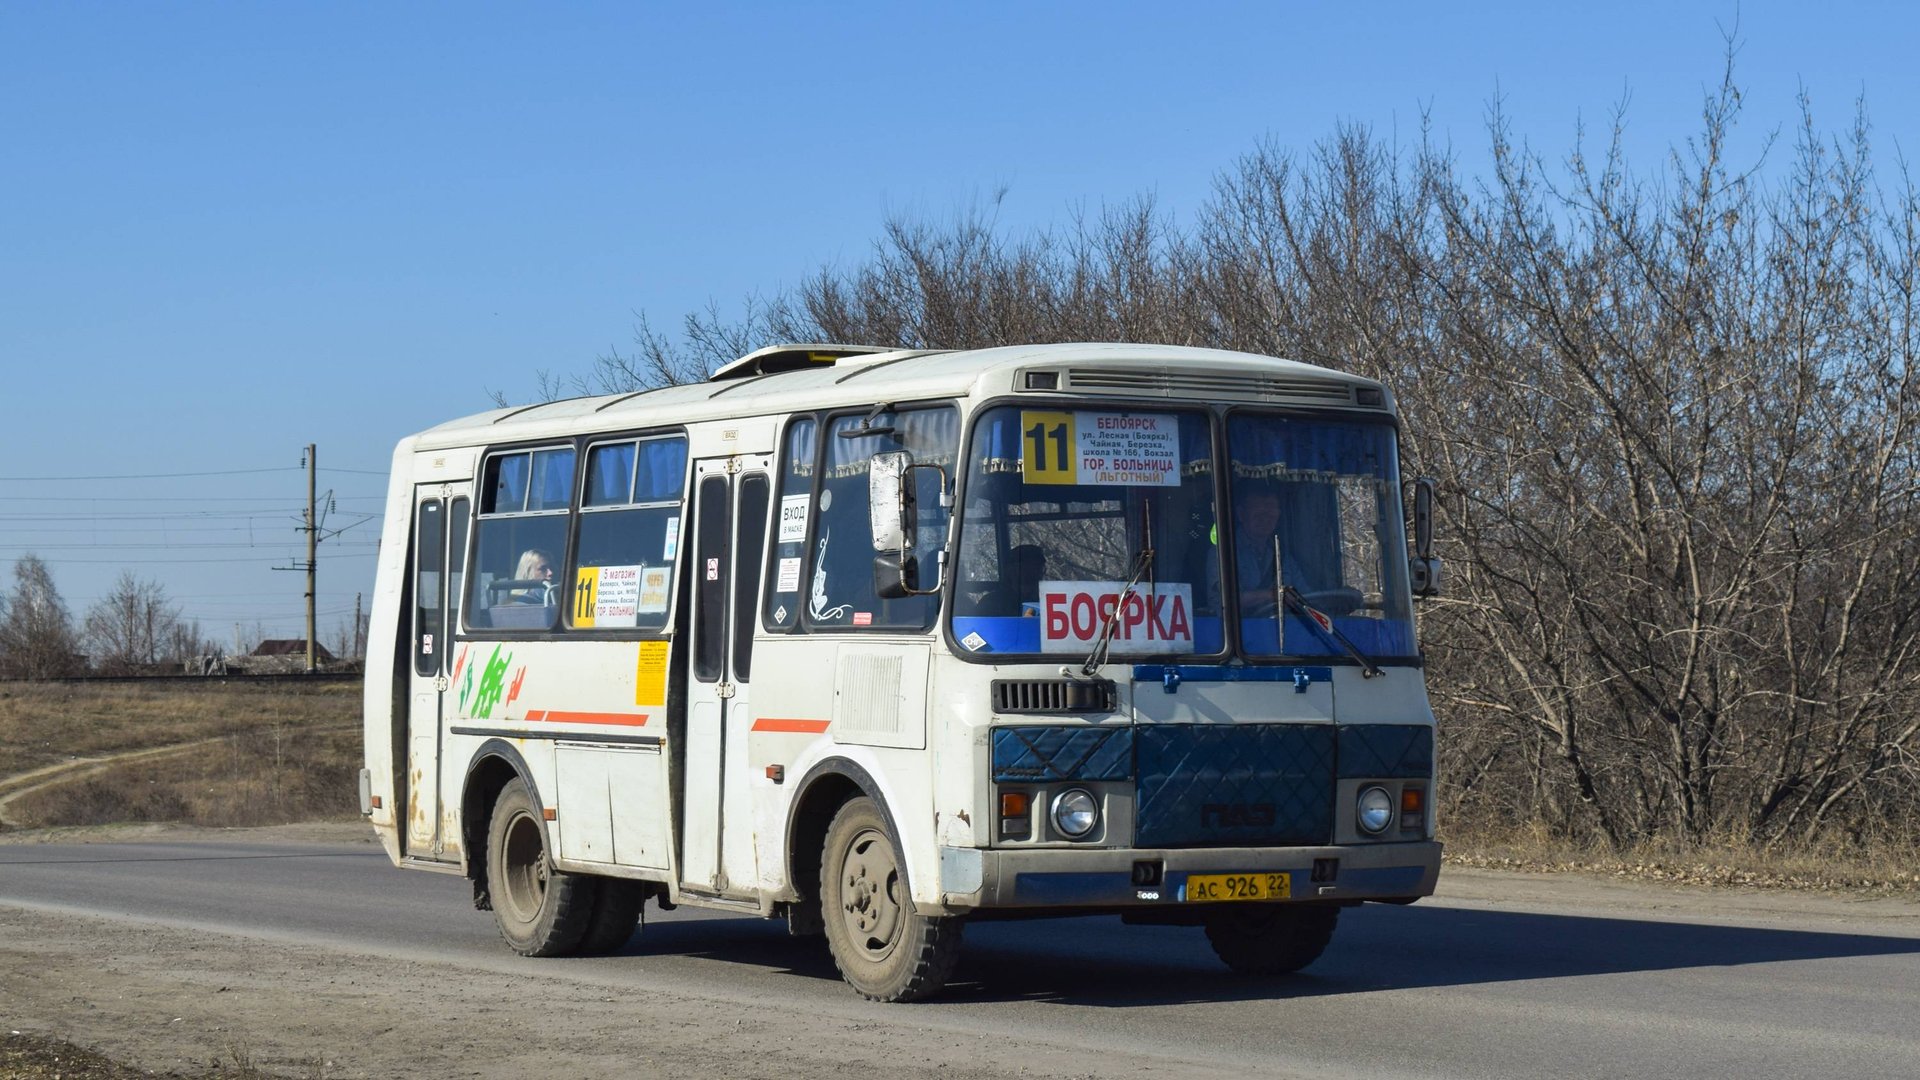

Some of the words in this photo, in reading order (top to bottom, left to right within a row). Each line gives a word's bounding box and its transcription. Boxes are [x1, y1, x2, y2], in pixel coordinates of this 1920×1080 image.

[1097, 417, 1157, 430] БЕЛОЯРСК
[1082, 432, 1095, 441] ул.
[1099, 431, 1130, 440] Лесная
[1025, 422, 1069, 471] 11
[1090, 439, 1125, 449] Чайная,
[1083, 449, 1110, 457] школа
[1144, 450, 1174, 458] Вокзал
[1083, 458, 1109, 471] ГОР.
[1113, 459, 1174, 472] БОЛЬНИЦА
[1095, 470, 1165, 484] (ЛЬГОТНЫЙ)
[783, 505, 805, 521] ВХОД
[788, 525, 803, 533] МАСКЕ
[604, 568, 609, 579] 5
[610, 570, 636, 579] магазин
[1045, 592, 1191, 641] БОЯРКА
[1226, 877, 1259, 897] 926
[1268, 875, 1284, 890] 22
